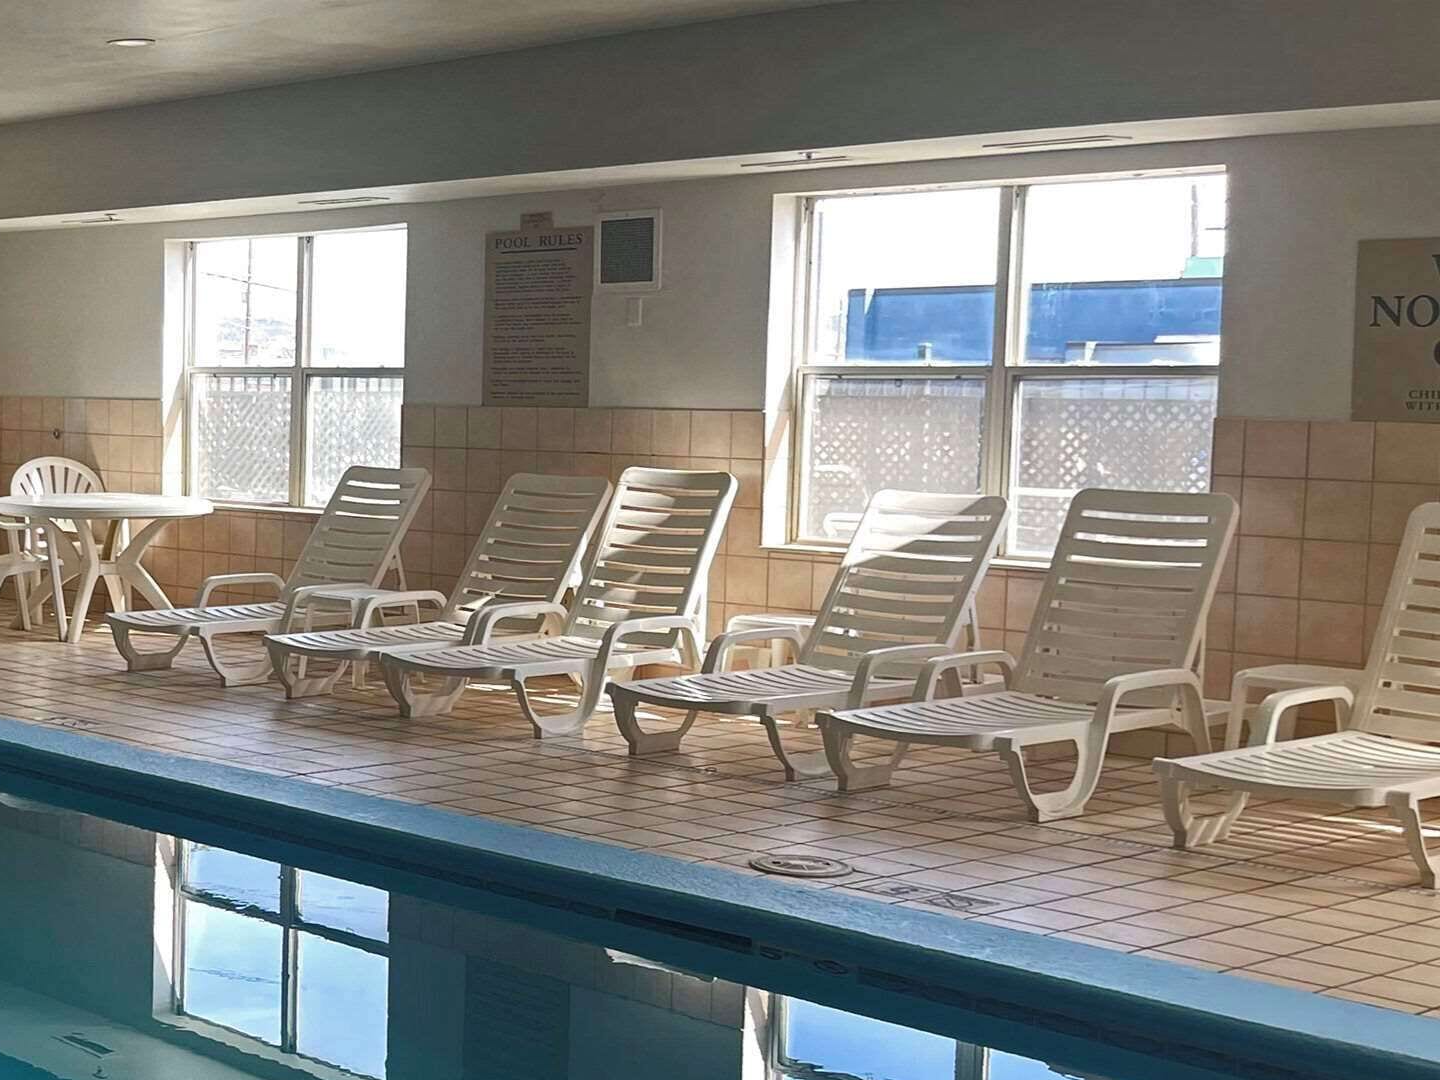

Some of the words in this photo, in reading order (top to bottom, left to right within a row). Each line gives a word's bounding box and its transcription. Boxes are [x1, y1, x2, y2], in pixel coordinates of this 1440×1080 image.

[495, 236, 531, 250] POOL
[538, 233, 584, 247] RULES
[1408, 389, 1440, 399] CHI
